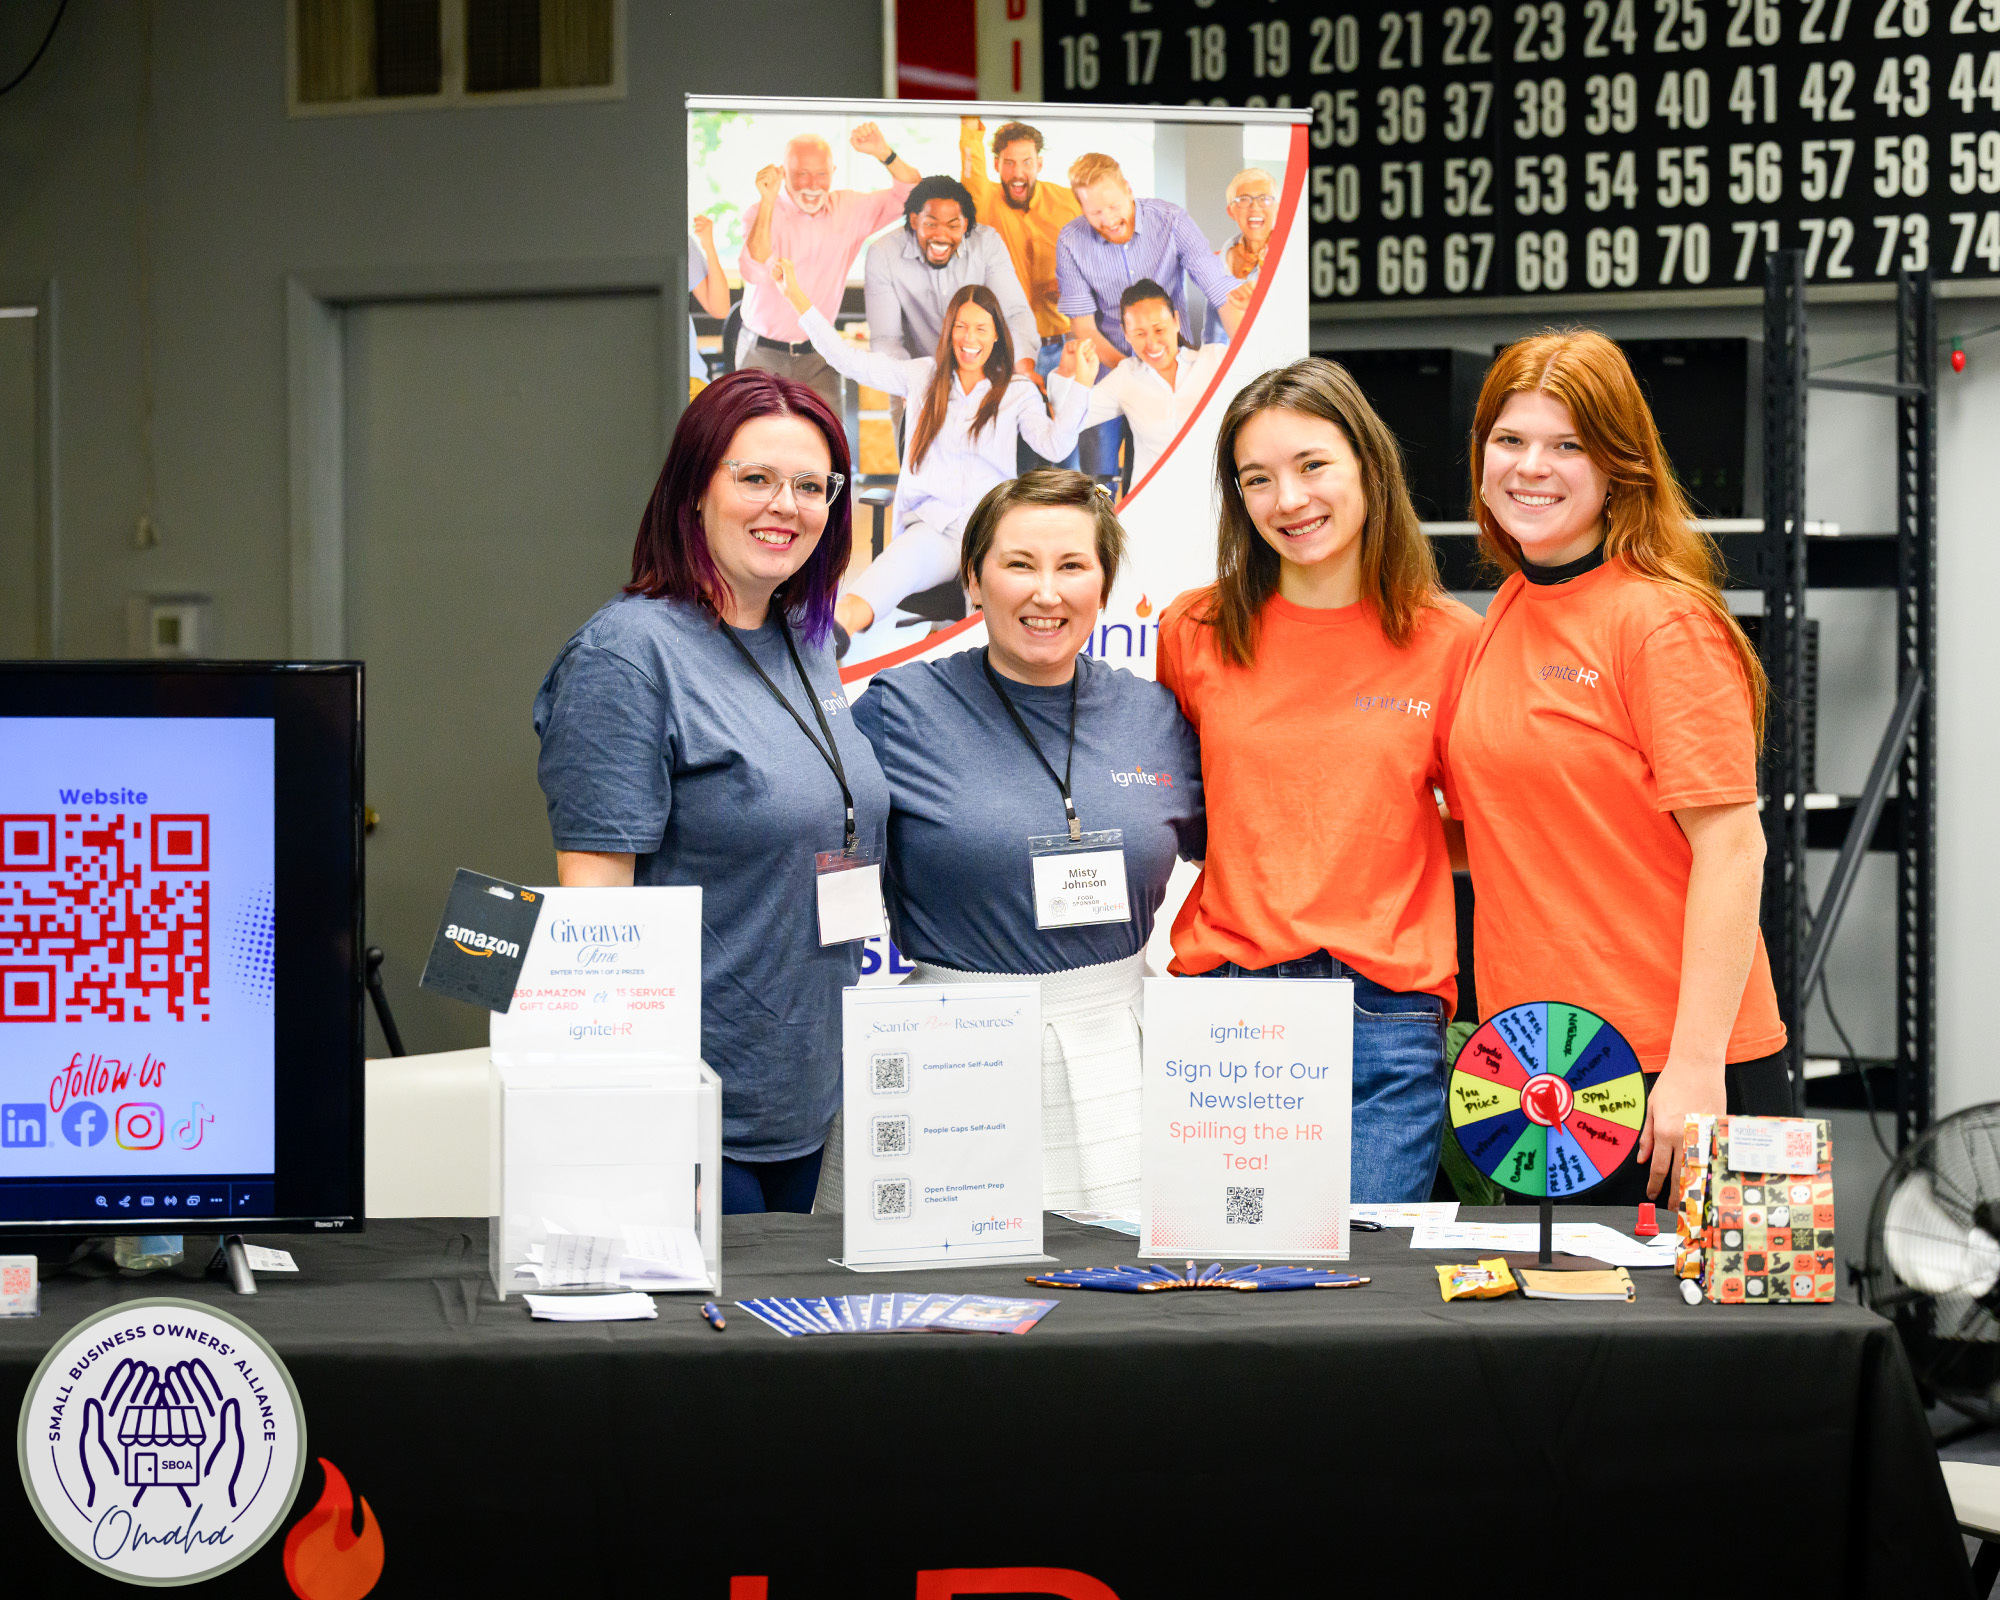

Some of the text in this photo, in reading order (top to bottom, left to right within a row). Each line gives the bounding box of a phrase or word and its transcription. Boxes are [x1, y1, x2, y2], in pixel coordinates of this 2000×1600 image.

[1061, 34, 1099, 89] 16
[1124, 30, 1161, 85] 17
[1187, 25, 1226, 81] 18
[1249, 20, 1290, 77] 19
[1311, 15, 1358, 74] 20
[1380, 12, 1421, 69] 21
[1443, 6, 1491, 65] 22
[1514, 1, 1565, 62] 23
[1584, 0, 1637, 58] 24
[1654, 0, 1707, 53] 25
[1726, 0, 1781, 48] 26
[1799, 0, 1852, 44] 27
[1873, 0, 1930, 40] 28
[1309, 50, 2000, 149] 35 36 37 38 39 40 41 42 43 44
[1312, 130, 2000, 223] 50 51 52 53 54 55 56 57 58 59
[1311, 238, 1360, 297] 65
[1377, 235, 1427, 295] 66
[1444, 233, 1495, 293] 67
[1515, 229, 1568, 292] 68
[1586, 226, 1639, 289] 69
[1656, 222, 1710, 285] 70
[1798, 216, 1855, 279] 72
[1873, 212, 1930, 277] 73
[1948, 210, 2000, 274] 74
[1539, 661, 1599, 688] igniteHR
[1354, 692, 1431, 718] igniteHR
[1110, 765, 1174, 789] igniteHR
[59, 787, 148, 805] Website
[1069, 868, 1097, 879] Misty
[1062, 879, 1107, 890] Johnson
[520, 891, 536, 902] $50
[1092, 902, 1125, 914] igniteHR
[445, 924, 520, 959] amazon
[550, 918, 645, 949] Giveaway
[577, 943, 619, 967] Time
[536, 988, 586, 998] AMAZON
[616, 987, 676, 997] 15 SERVICE
[519, 1001, 579, 1011] GIFT CARD
[627, 1001, 665, 1010] HOURS
[569, 1019, 633, 1040] igniteHR
[872, 1021, 901, 1033] Scan
[902, 1019, 920, 1032] for
[955, 1017, 1014, 1029] Resources
[1210, 1019, 1285, 1043] igniteHR
[923, 1060, 1003, 1071] Compliance Self-Audit
[1166, 1059, 1329, 1083] Sign Up for Our
[1190, 1091, 1304, 1109] Newsletter
[970, 1123, 1006, 1131] Self-Audit
[1169, 1121, 1323, 1145] Spilling the HR
[1223, 1153, 1268, 1170] Tea!
[946, 1184, 986, 1192] Enrollment
[924, 1195, 958, 1203] Checklist
[971, 1216, 1023, 1235] igniteHR
